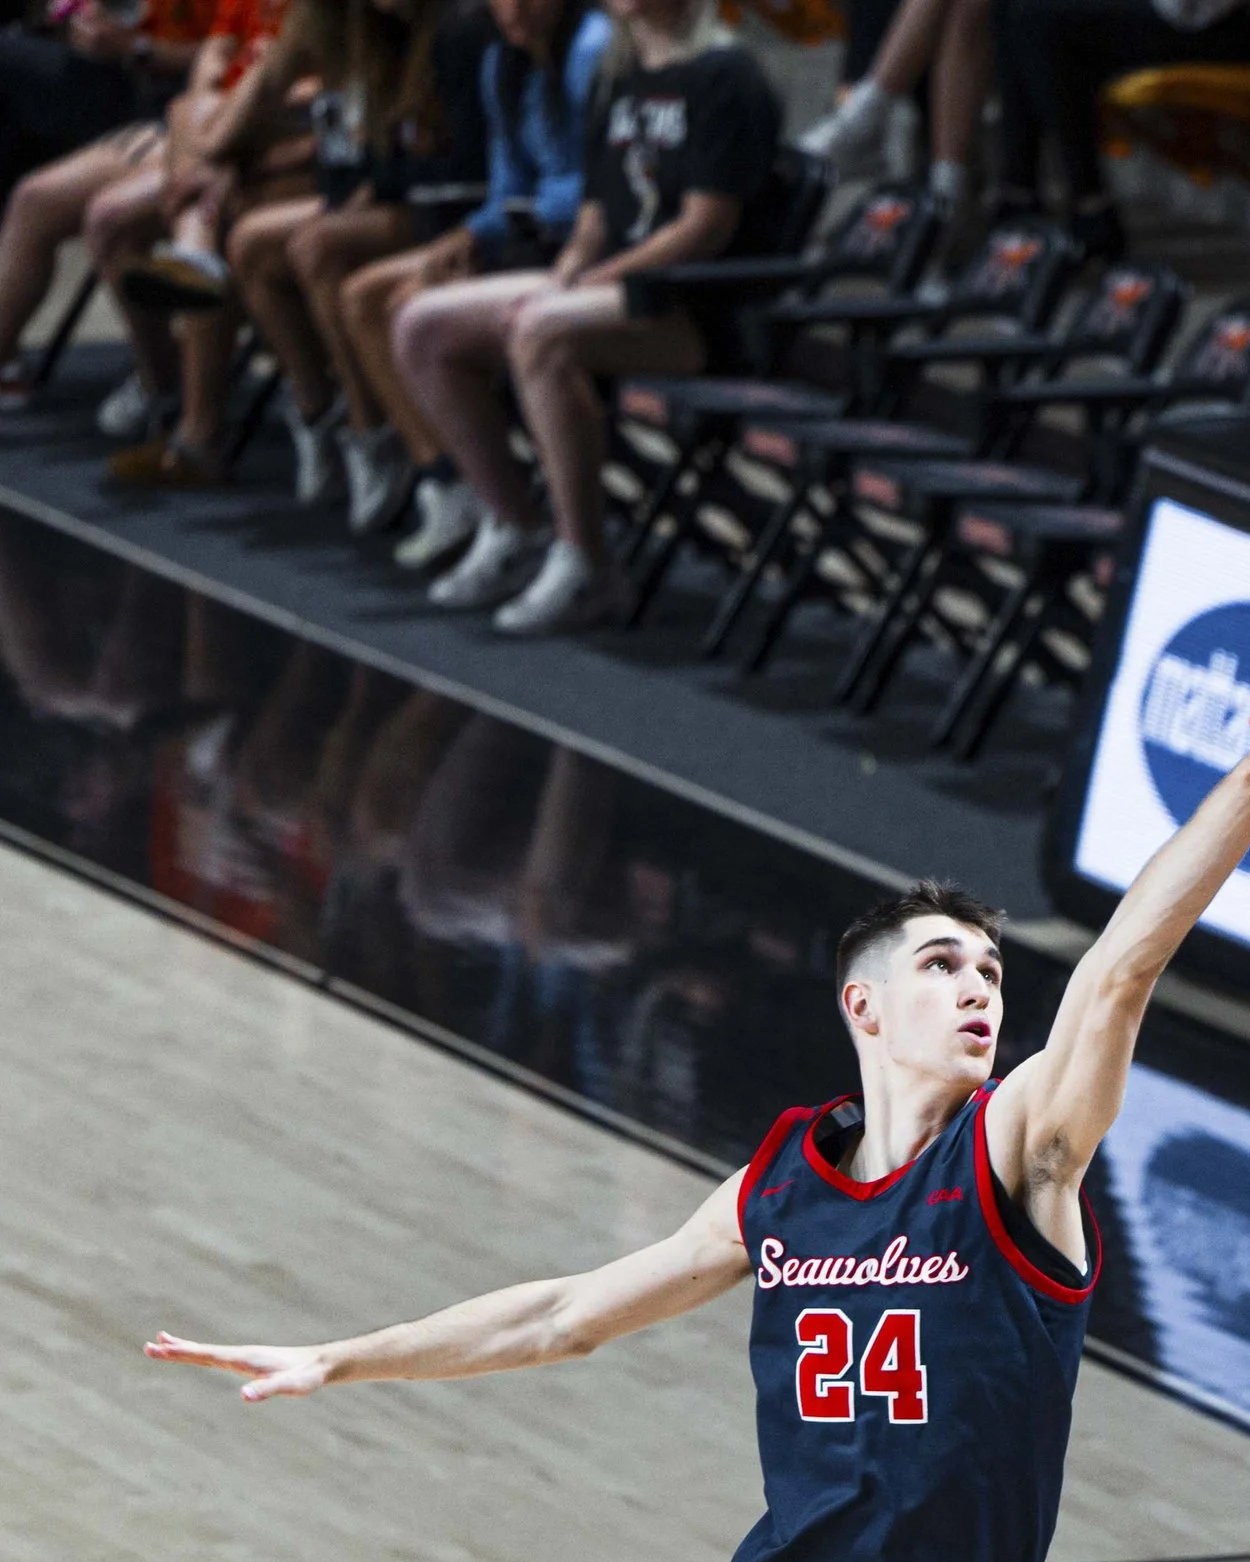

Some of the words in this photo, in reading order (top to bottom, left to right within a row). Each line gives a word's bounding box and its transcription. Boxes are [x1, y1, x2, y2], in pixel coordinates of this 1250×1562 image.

[927, 1186, 963, 1206] CAA
[758, 1235, 970, 1290] Seawolves
[795, 1308, 928, 1424] 24
